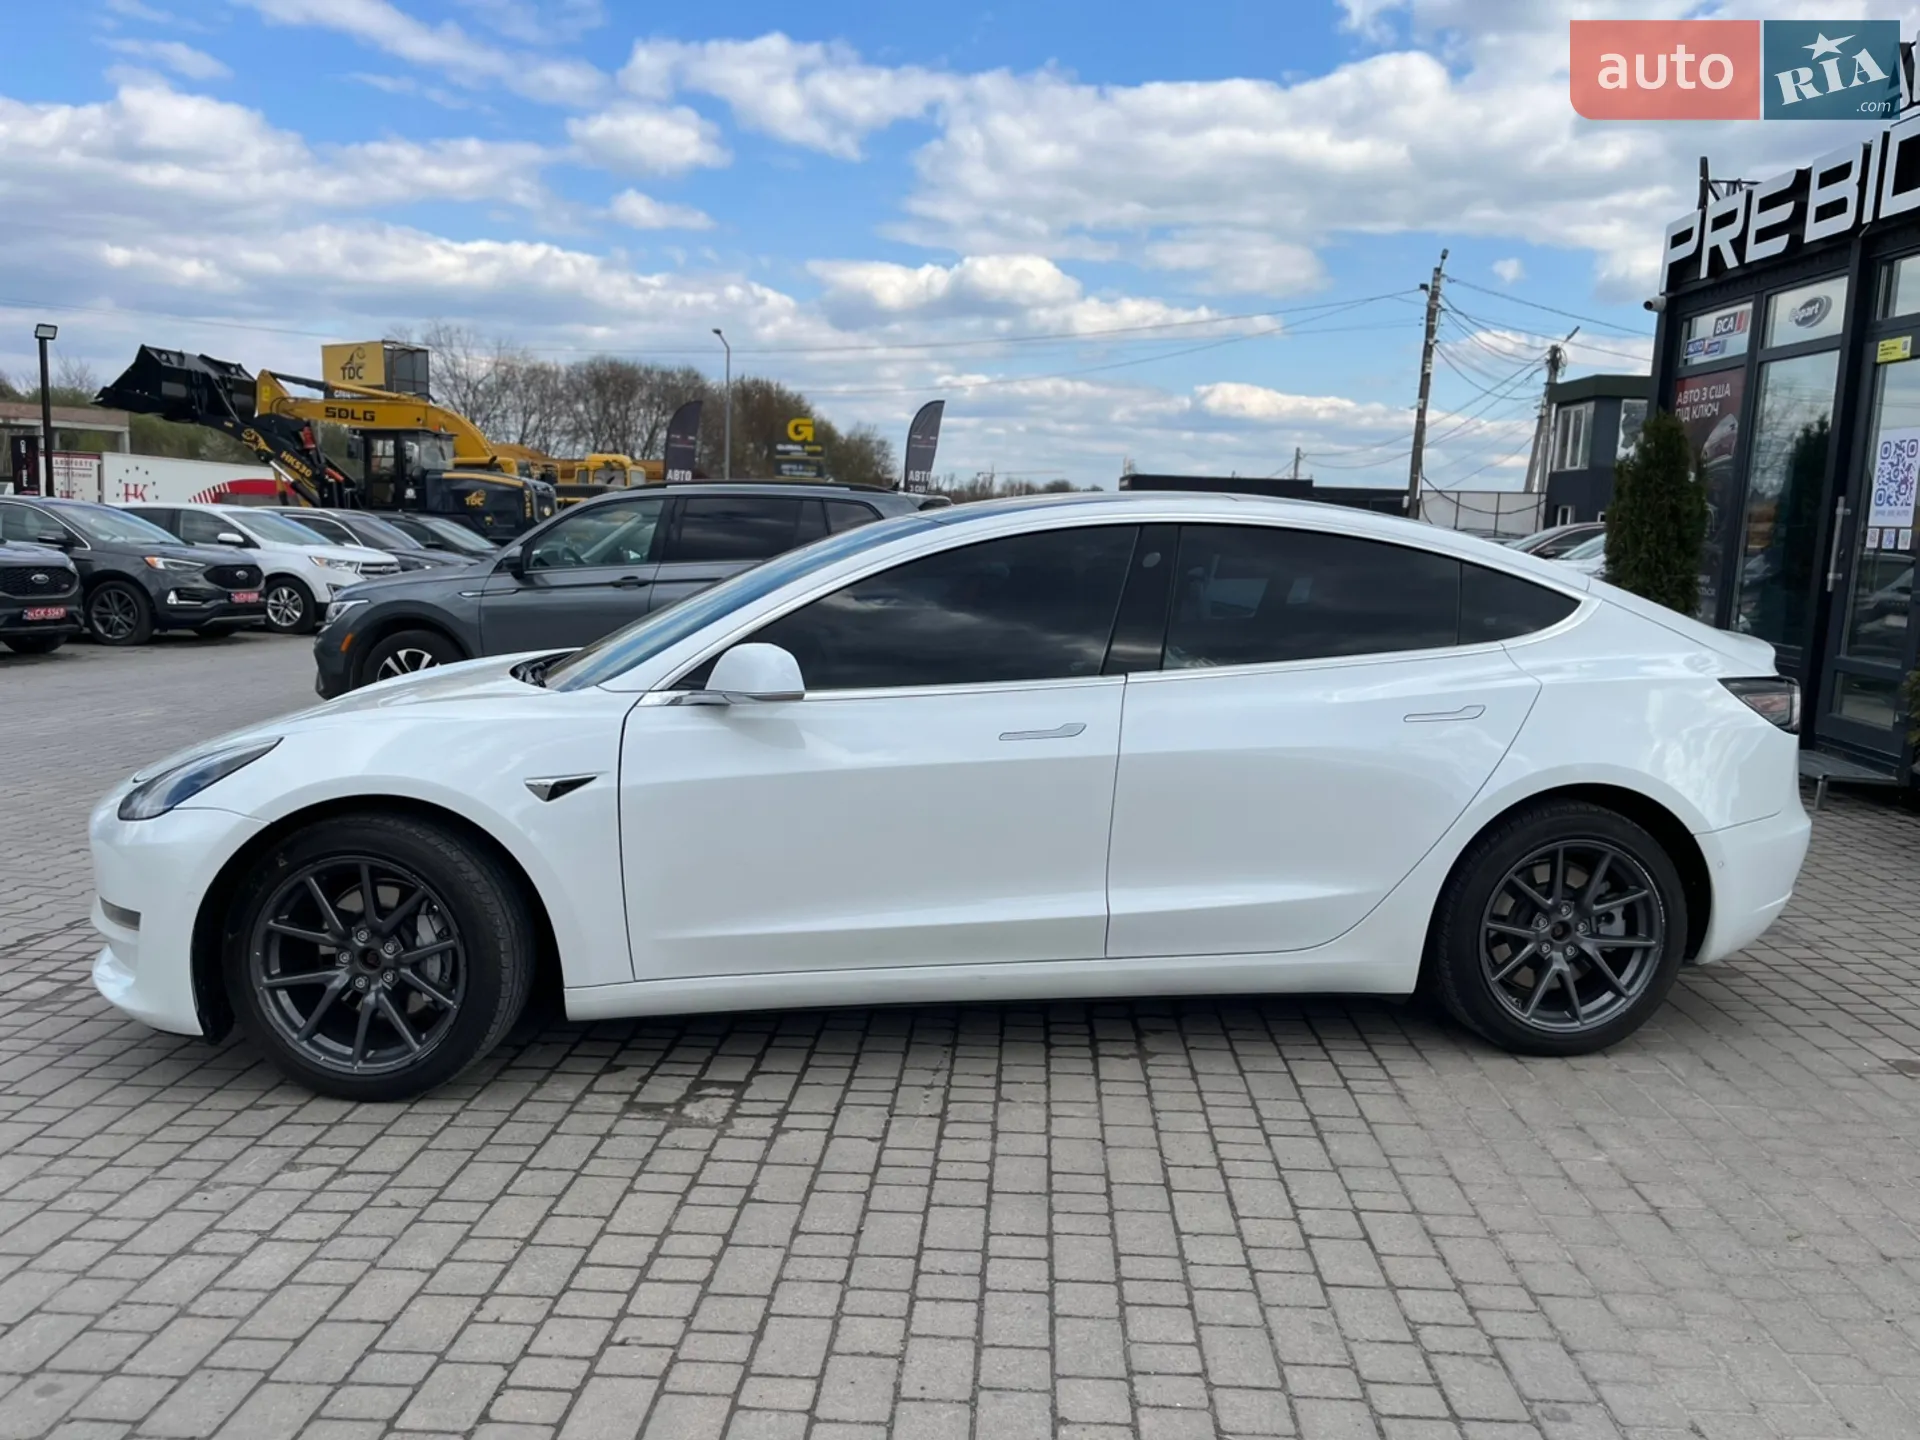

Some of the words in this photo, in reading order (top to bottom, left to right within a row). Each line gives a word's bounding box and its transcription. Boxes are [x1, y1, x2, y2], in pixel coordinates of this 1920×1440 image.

[1716, 318, 1734, 335] BCA
[340, 366, 366, 381] TDC
[1676, 388, 1700, 405] АВТО
[1702, 386, 1708, 401] З
[1709, 383, 1731, 400] США
[325, 407, 375, 422] SDLG
[1691, 402, 1720, 419] КЛЮЧ
[667, 469, 692, 481] АВТО
